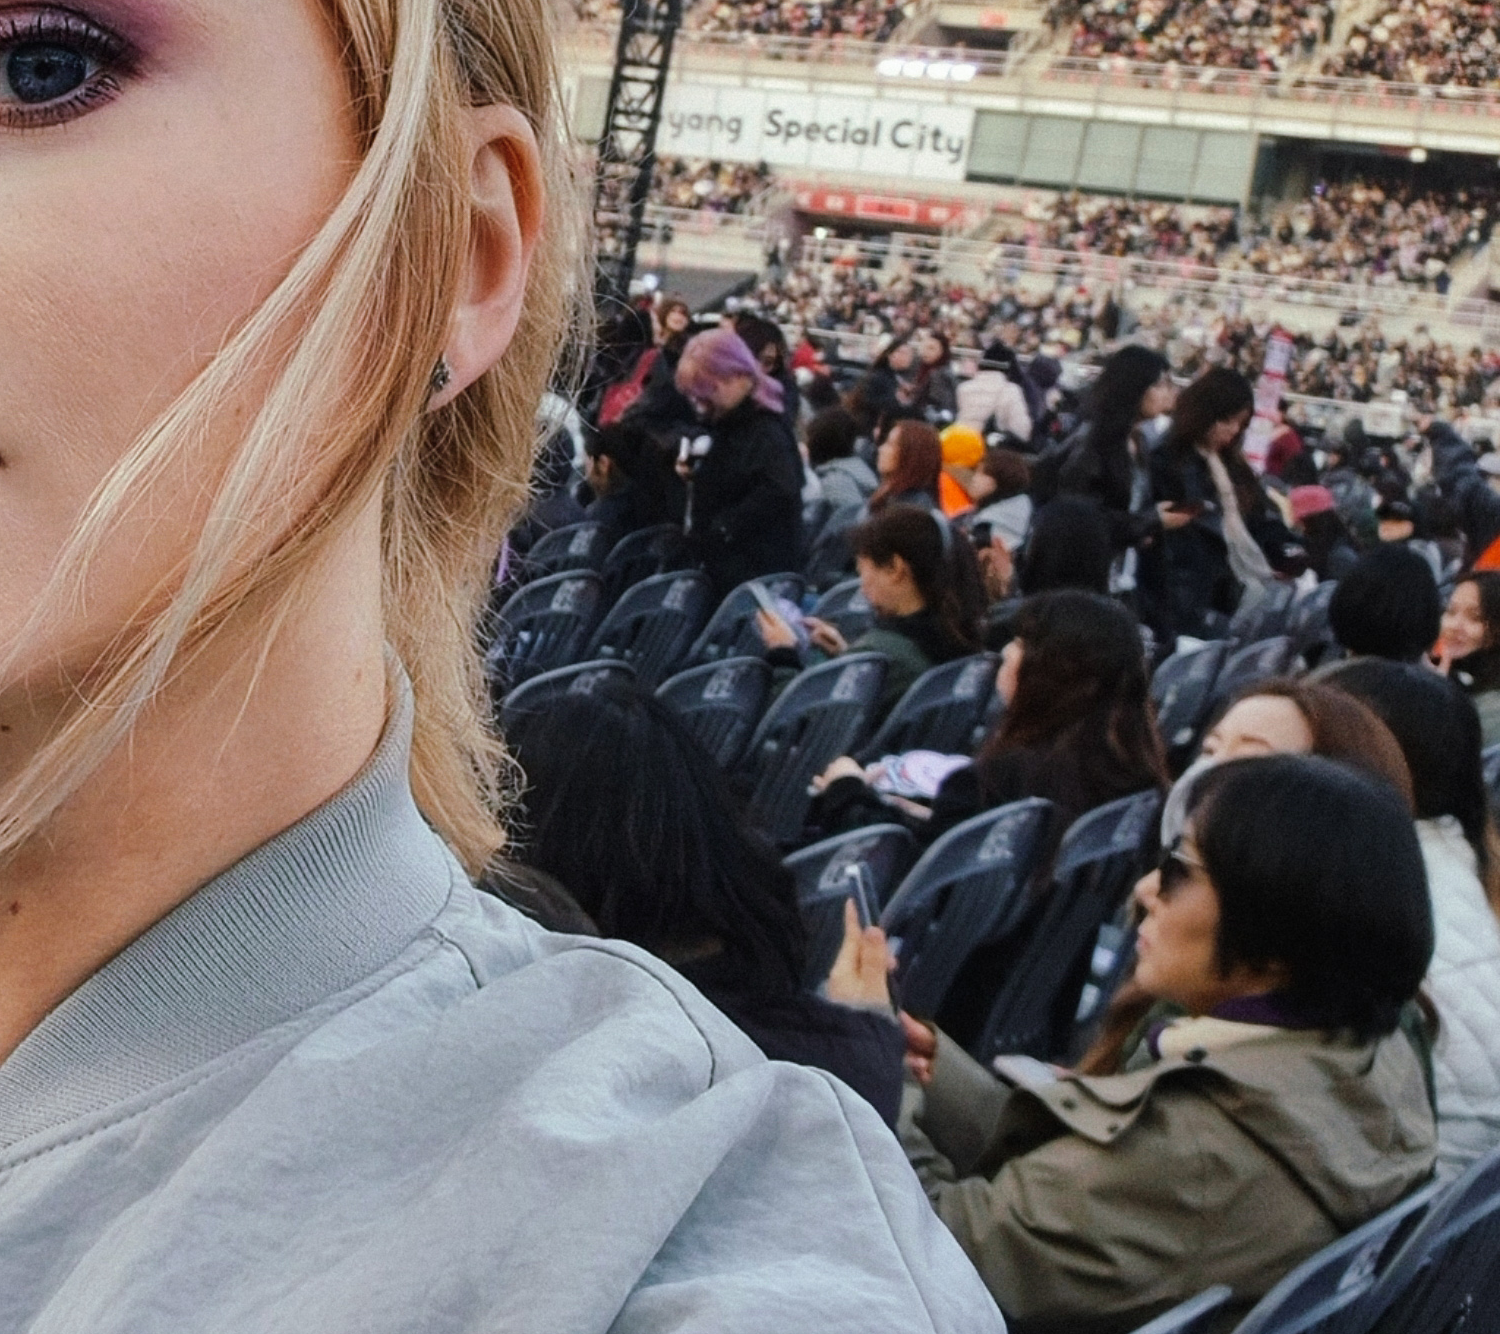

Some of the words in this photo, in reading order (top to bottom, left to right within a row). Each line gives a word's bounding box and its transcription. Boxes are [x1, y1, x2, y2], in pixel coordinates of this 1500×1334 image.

[668, 111, 743, 143] yang
[763, 109, 881, 148] Special
[889, 119, 965, 164] City
